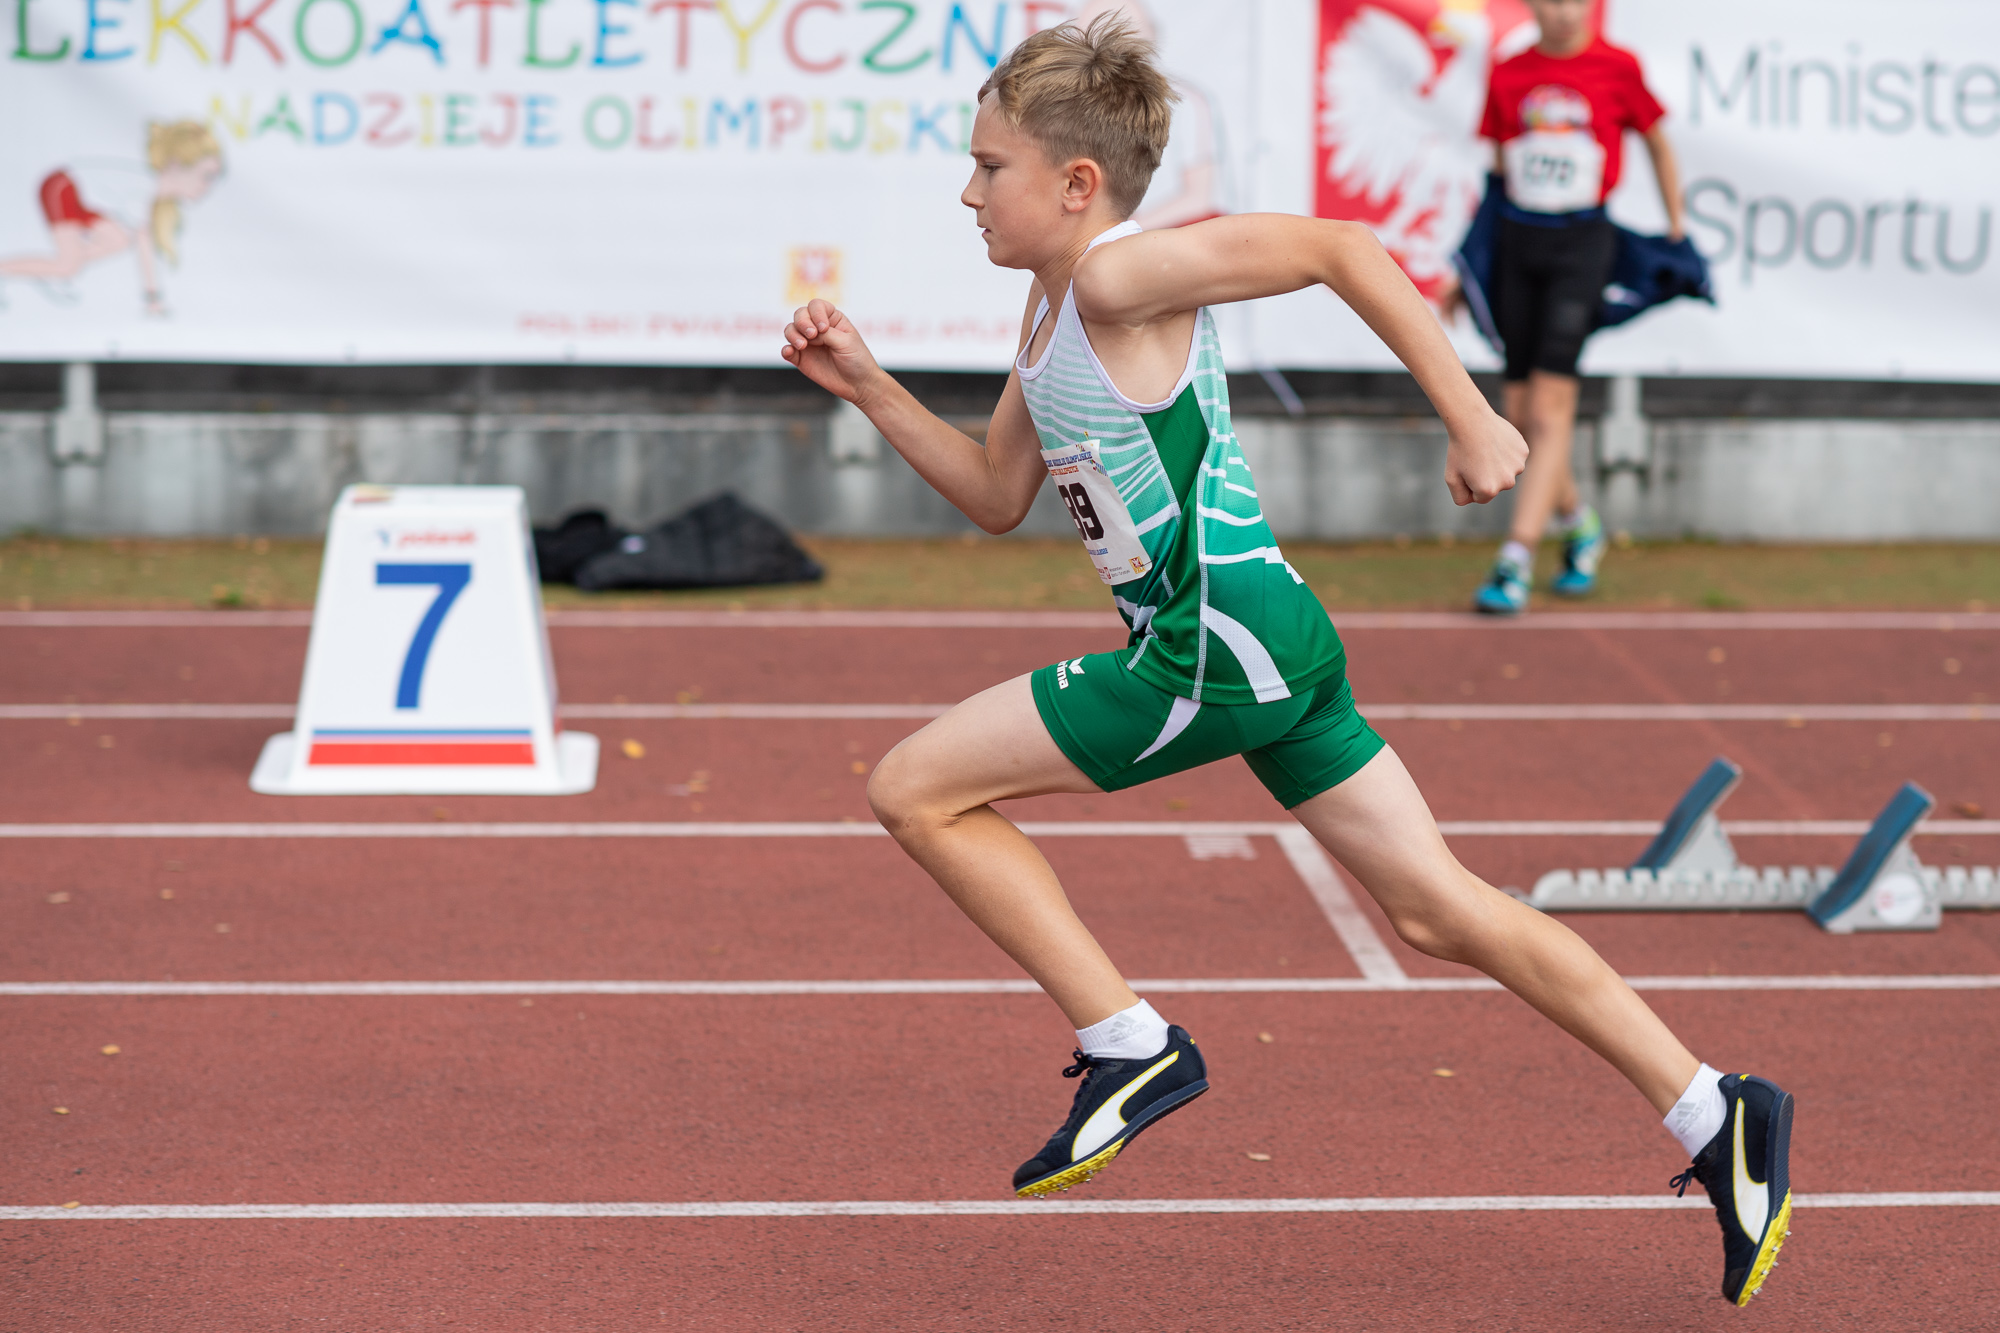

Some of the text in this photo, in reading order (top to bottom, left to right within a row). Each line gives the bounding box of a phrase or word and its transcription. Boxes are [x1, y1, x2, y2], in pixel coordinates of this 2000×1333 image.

[207, 93, 558, 149] NADZIEJE
[1688, 40, 2000, 136] Ministe
[1684, 176, 1992, 288] Sportu
[375, 564, 472, 709] 7
[1109, 1021, 1149, 1043] adidas
